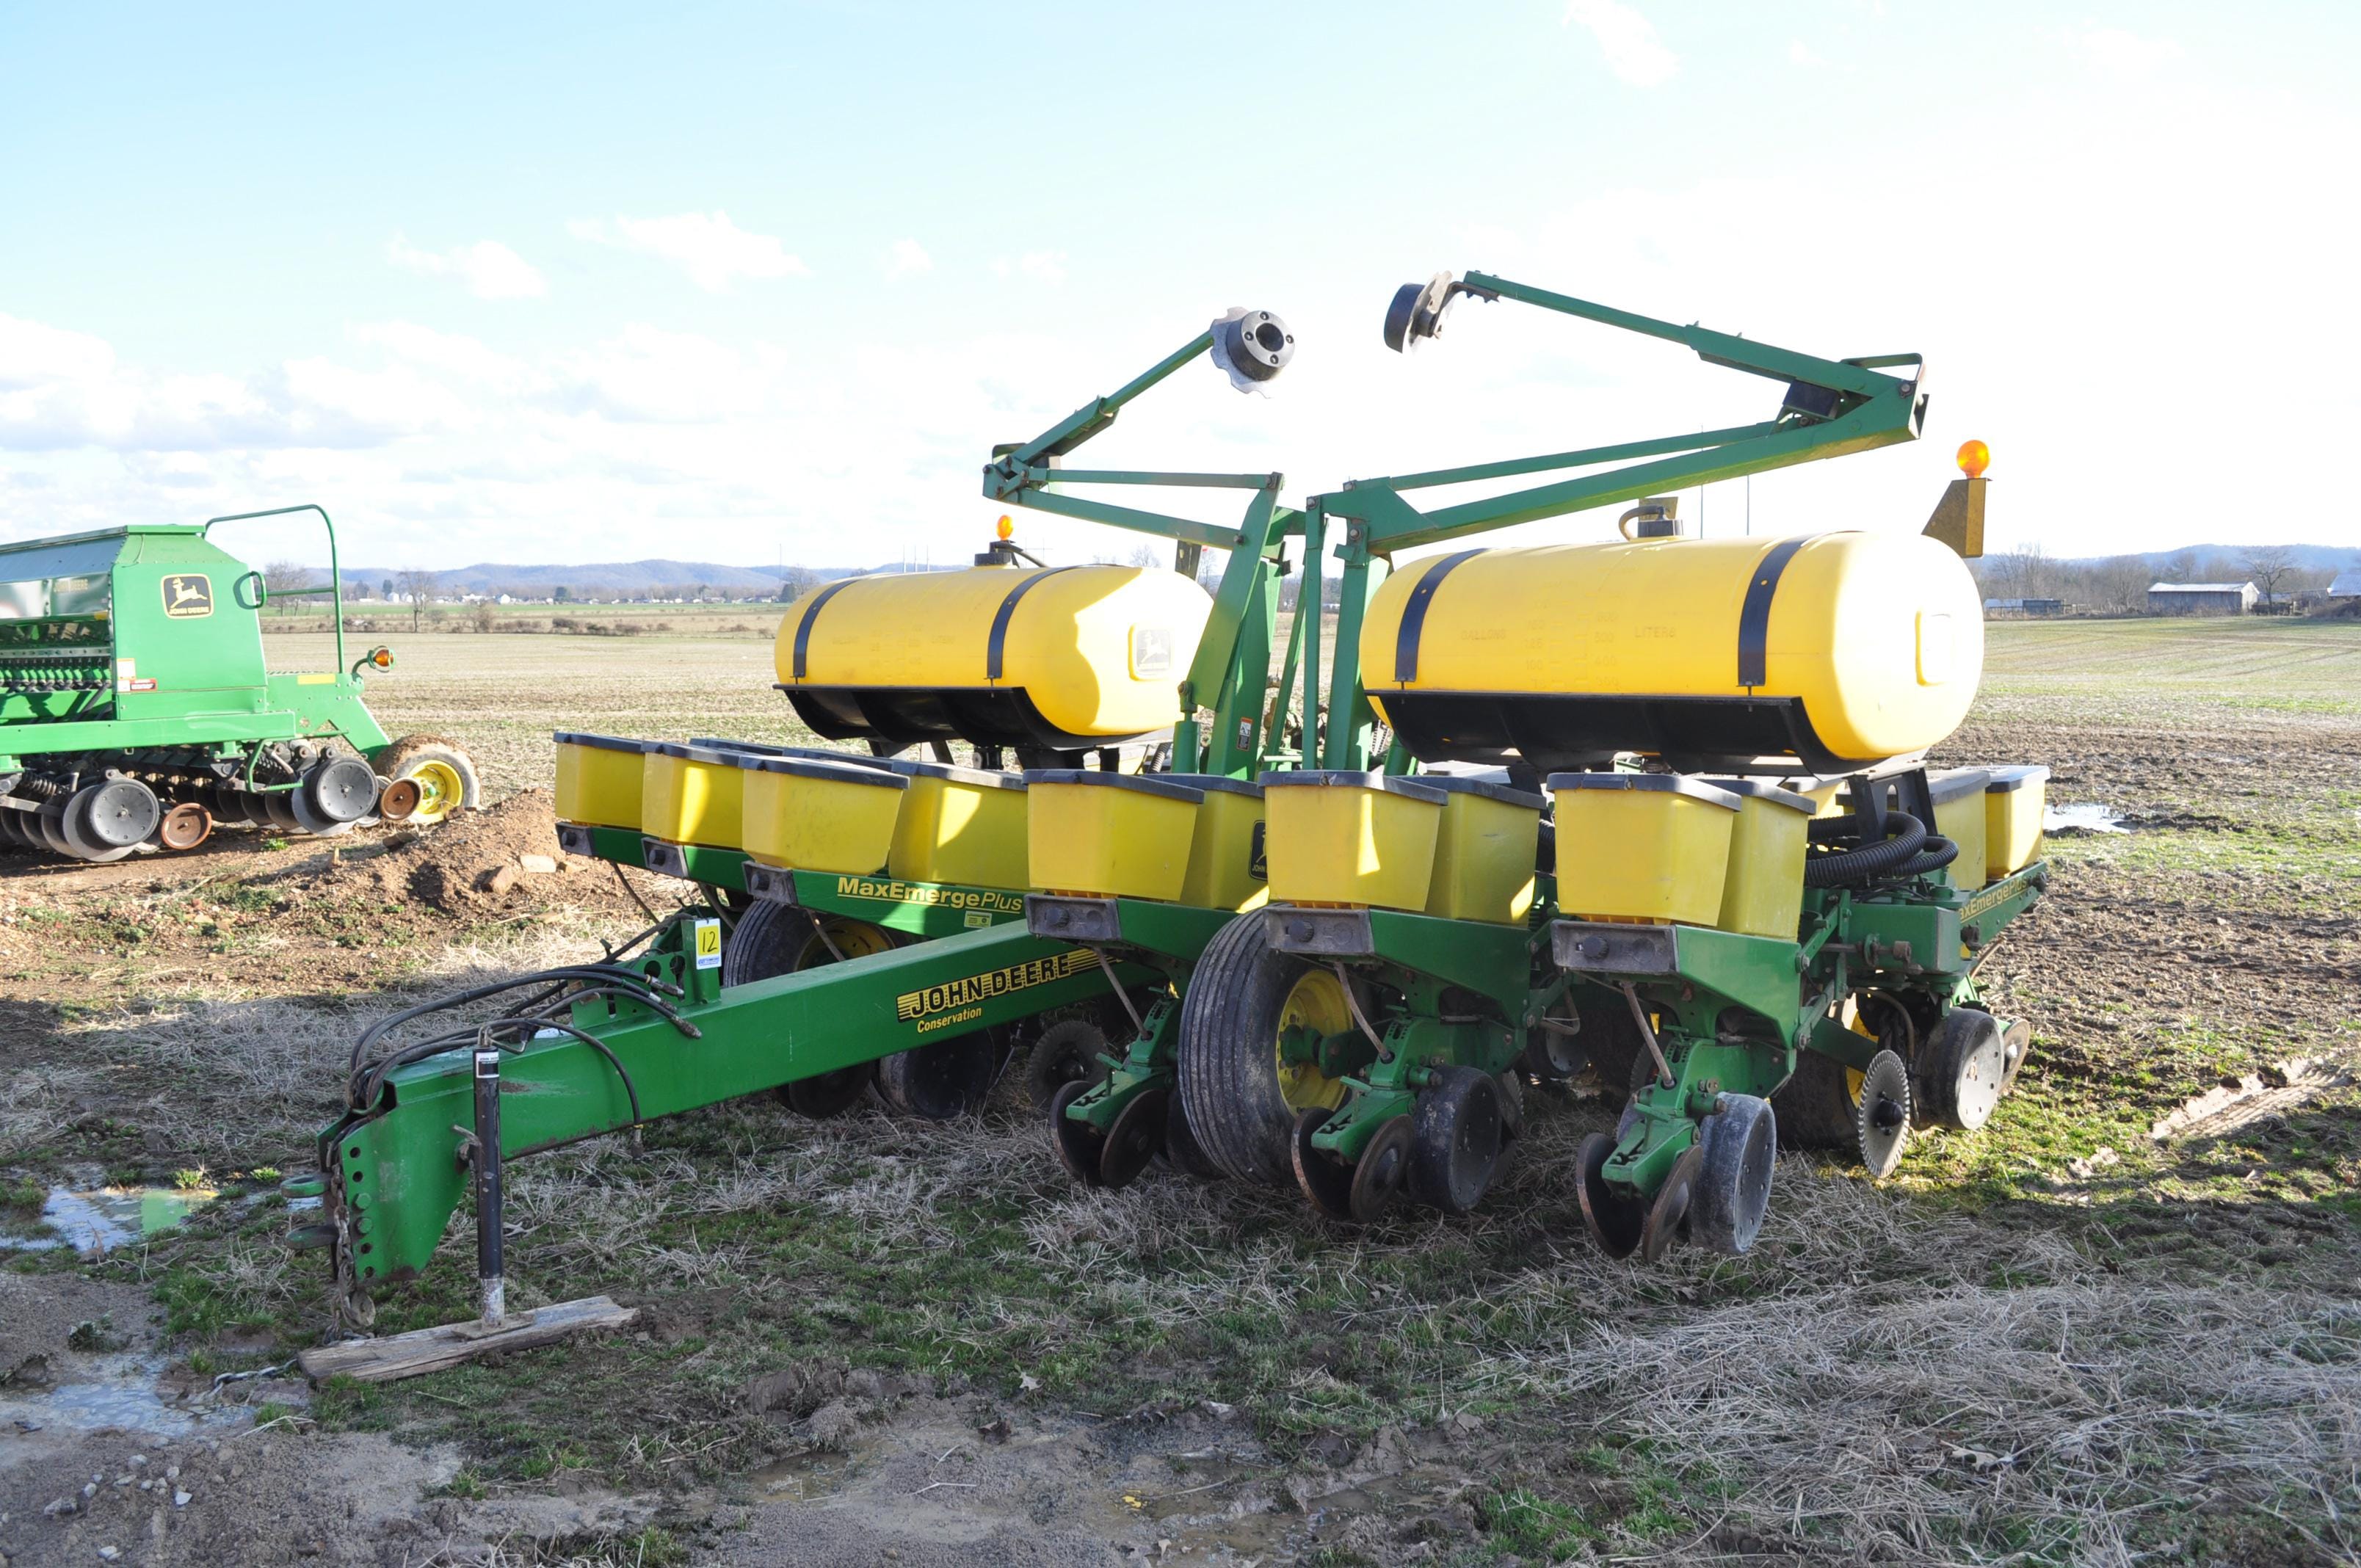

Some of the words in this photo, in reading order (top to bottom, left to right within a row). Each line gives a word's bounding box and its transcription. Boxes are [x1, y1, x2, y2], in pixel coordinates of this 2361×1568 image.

[1634, 626, 1677, 639] LITERS
[838, 876, 1023, 910] MaxEmergePlus
[1959, 874, 2028, 921] axEmergePlus
[703, 931, 717, 952] 12
[911, 977, 982, 1015] JOHN
[992, 954, 1070, 994] DEERE
[918, 1007, 982, 1033] Conservation
